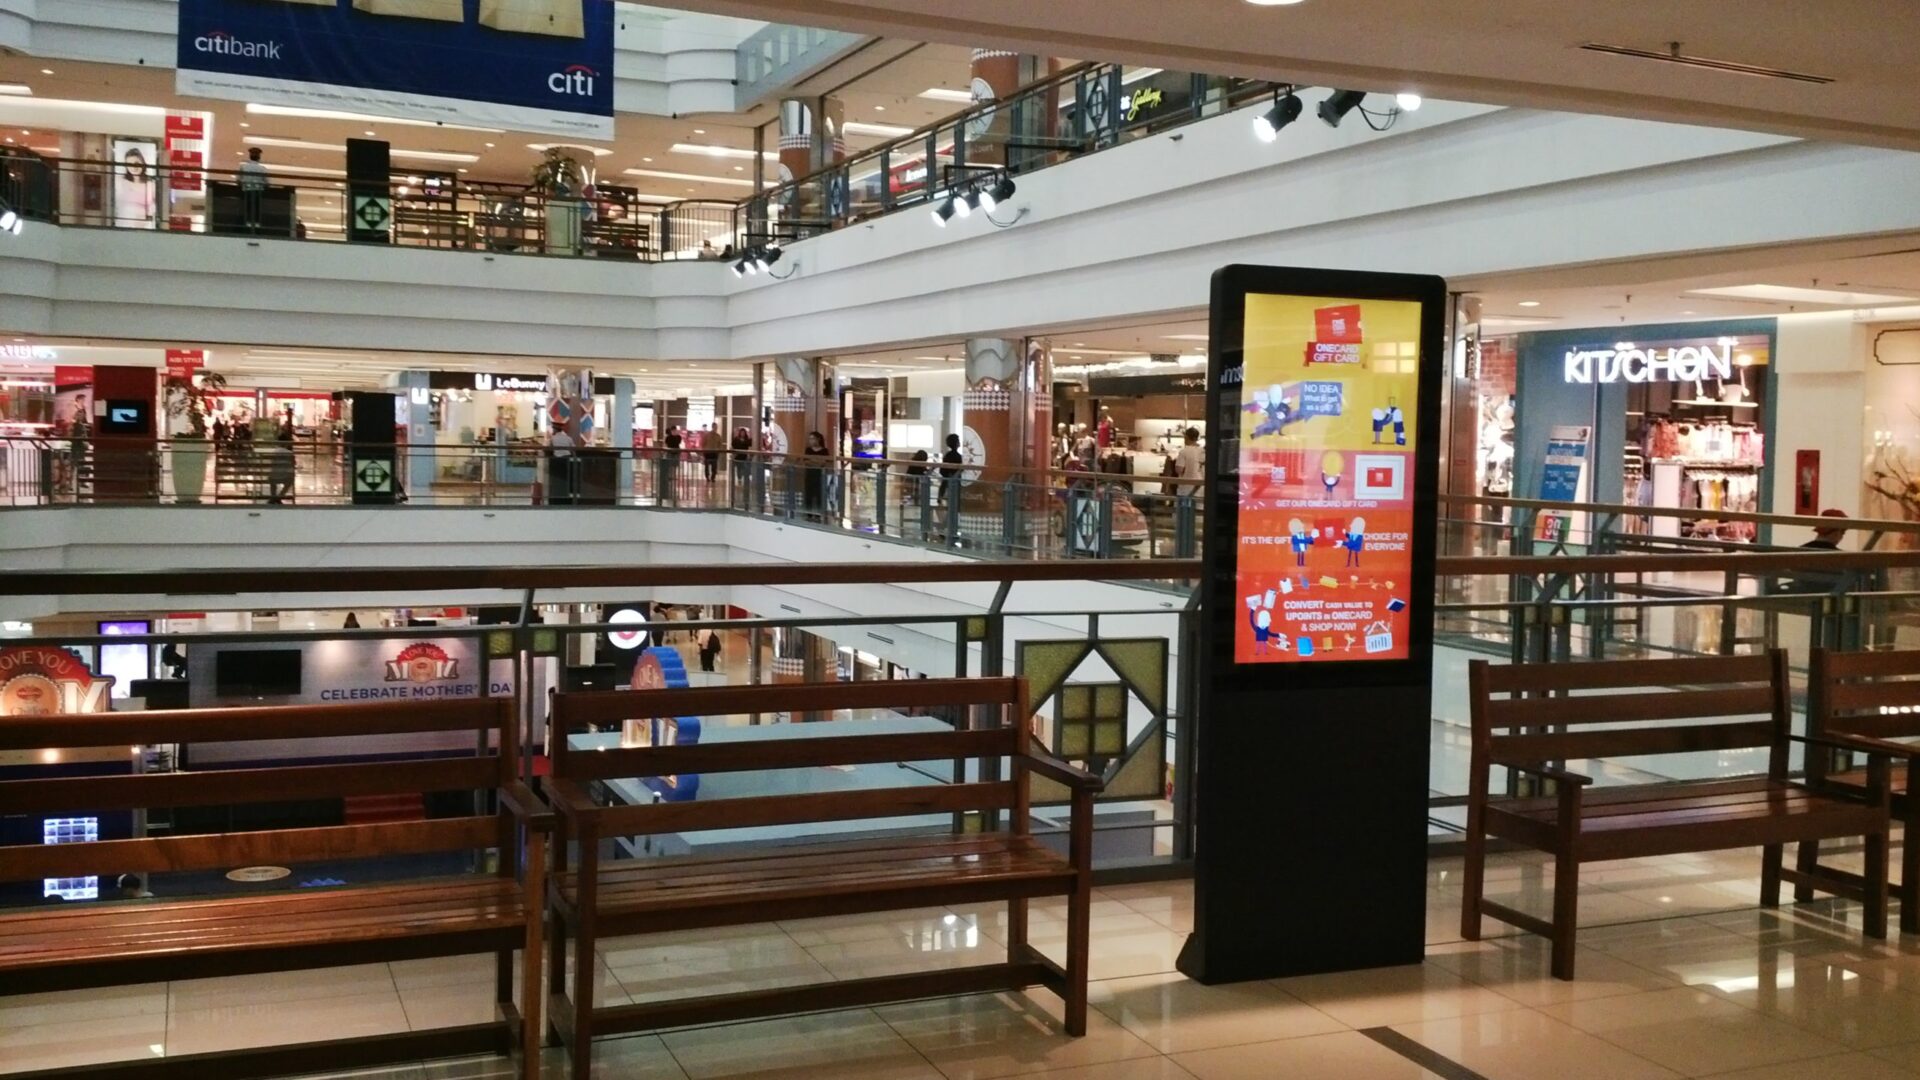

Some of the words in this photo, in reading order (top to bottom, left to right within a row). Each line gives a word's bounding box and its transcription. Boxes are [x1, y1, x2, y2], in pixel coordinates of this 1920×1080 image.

[194, 35, 281, 60] citibank
[547, 70, 593, 96] citi
[1315, 343, 1359, 353] ONECARD
[1313, 353, 1334, 362] GIFT
[1335, 354, 1360, 363] CARD
[1304, 384, 1318, 393] NO
[1319, 384, 1339, 393] IDEA
[1275, 500, 1290, 508] GET
[1291, 500, 1307, 508] OUR
[1357, 500, 1377, 508] CARD
[1242, 536, 1257, 545] IT'S
[1258, 536, 1273, 545] THE
[1274, 536, 1291, 545] GIFT
[1363, 533, 1392, 541] CHOICE
[1393, 533, 1408, 541] FOR
[1365, 543, 1405, 551] EVERYONE
[1284, 600, 1324, 609] CONVERT
[1285, 611, 1323, 620] UPOINTS
[1332, 611, 1373, 620] ONECARD
[1309, 623, 1333, 631] SHOP
[1333, 622, 1357, 631] NOW!
[38, 651, 74, 675] YOU
[320, 687, 408, 701] CELEBRATE
